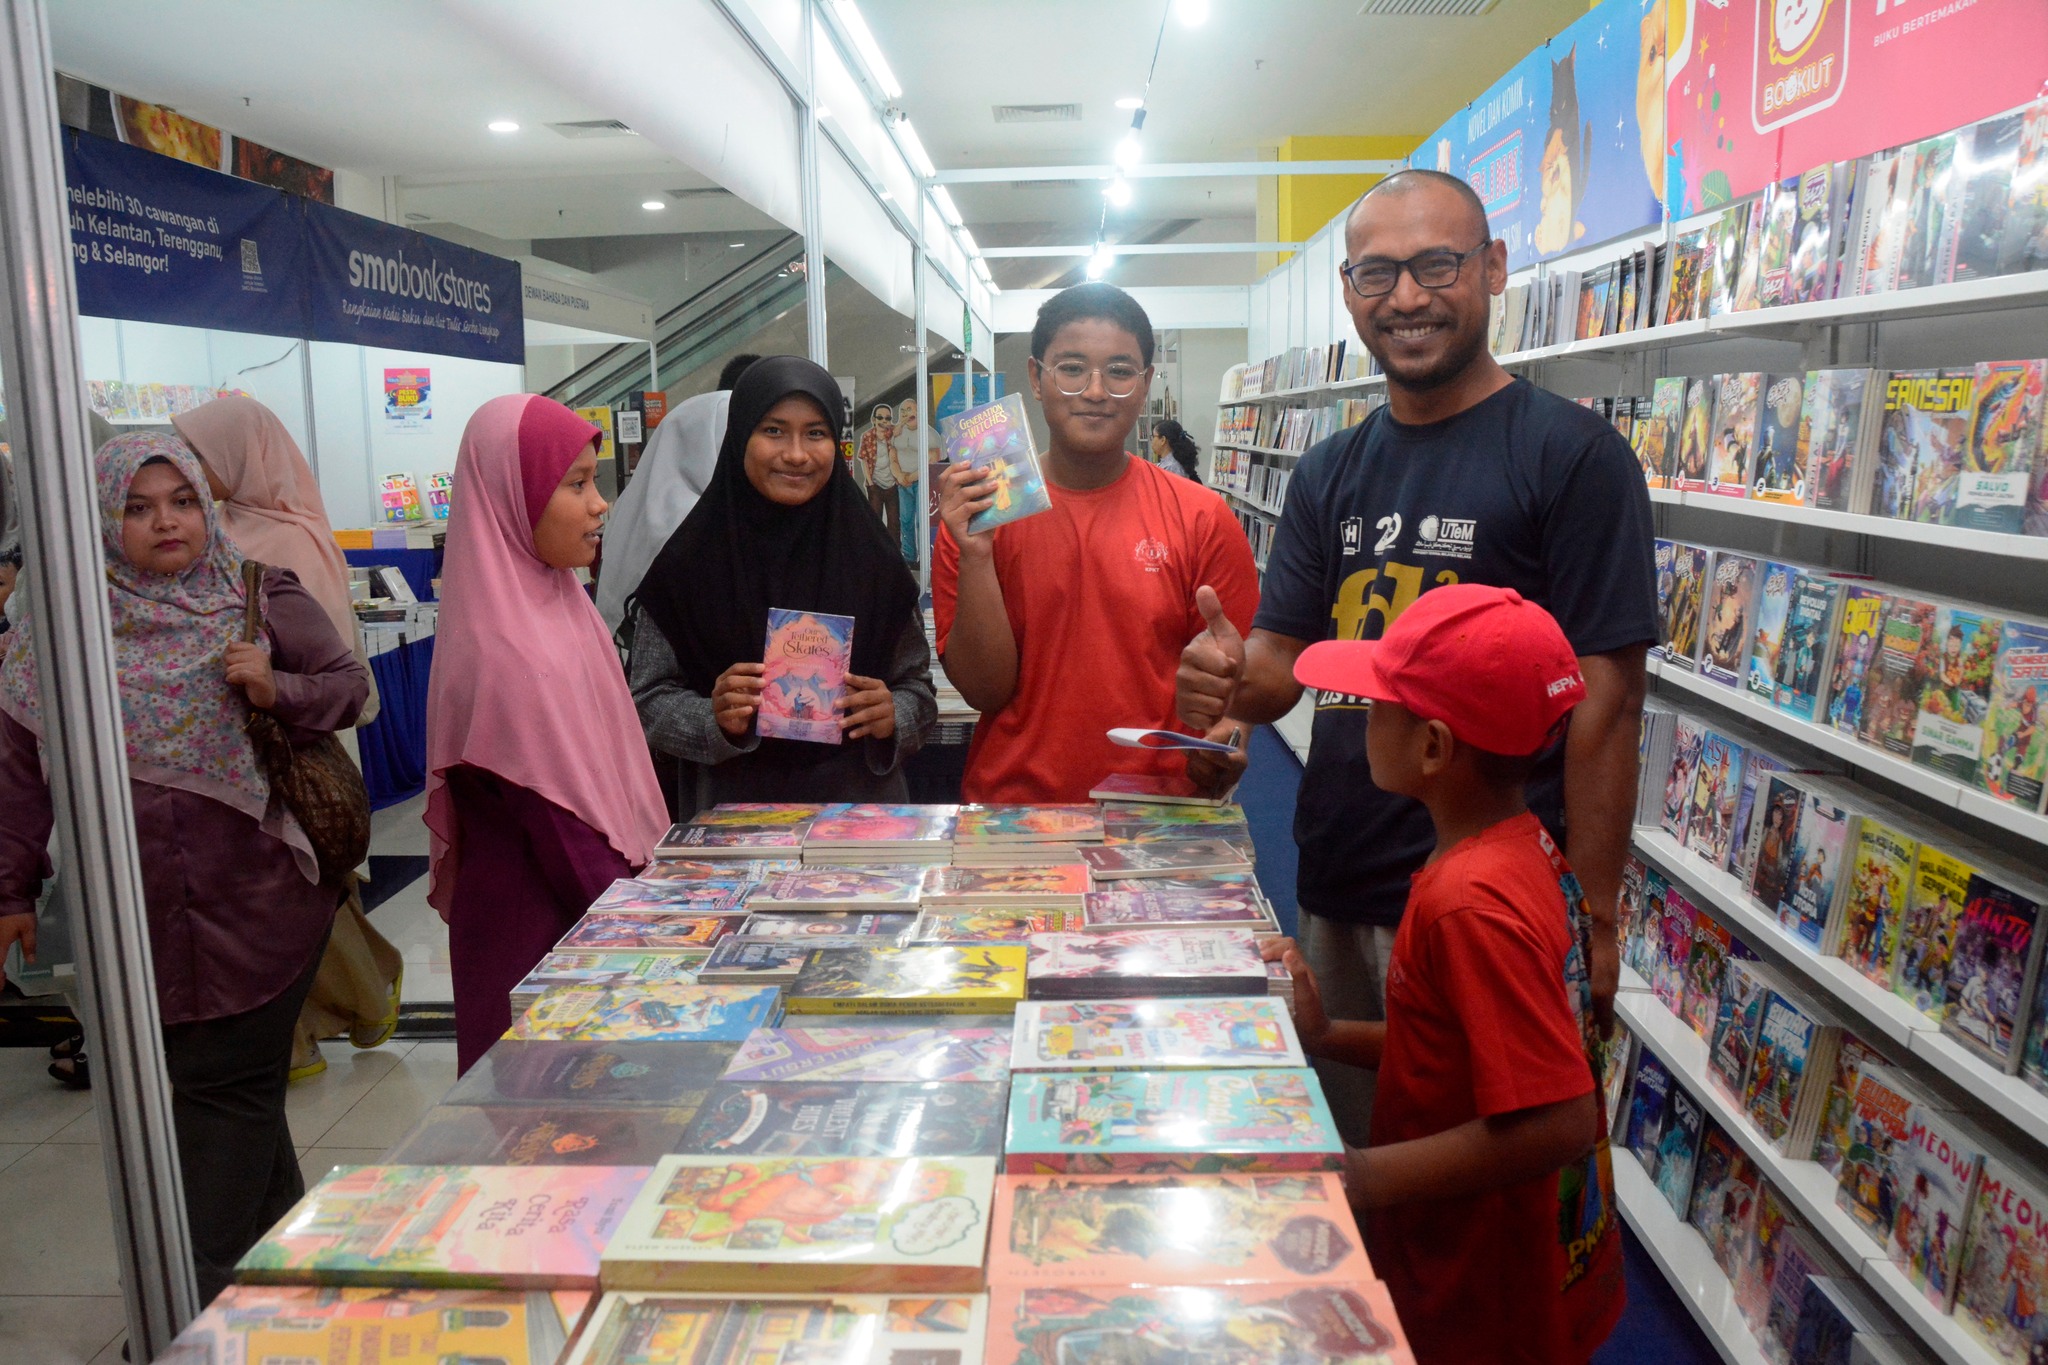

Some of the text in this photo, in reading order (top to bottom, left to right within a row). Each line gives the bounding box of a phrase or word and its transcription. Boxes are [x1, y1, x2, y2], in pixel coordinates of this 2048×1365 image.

[1873, 27, 1900, 47] BUKU
[1467, 75, 1524, 145] NOVEL DAN KOMIK
[1470, 147, 1519, 206] BLINK
[126, 195, 143, 217] 30
[145, 204, 205, 233] cawangan
[207, 216, 220, 235] di
[87, 212, 155, 248] Kelantan,
[156, 227, 223, 262] Terengganu,
[91, 241, 102, 262] &
[104, 243, 169, 275] Selangor!
[342, 298, 382, 325] Rangkaian
[382, 305, 400, 323] Kedai
[401, 308, 421, 325] Buku
[524, 285, 590, 311] DEWAN BAHASA DAN PUSTAKA
[959, 403, 1003, 431] GENERATION
[967, 410, 1008, 440] WITCHES
[385, 477, 411, 490] abc
[1440, 522, 1475, 541] UTeM
[785, 640, 831, 658] Skates
[1546, 675, 1578, 698] HEPA
[1910, 1121, 1973, 1183] MEOW
[475, 1197, 518, 1231] Kita
[506, 1194, 552, 1237] Cerita
[548, 1197, 590, 1234] Rasa
